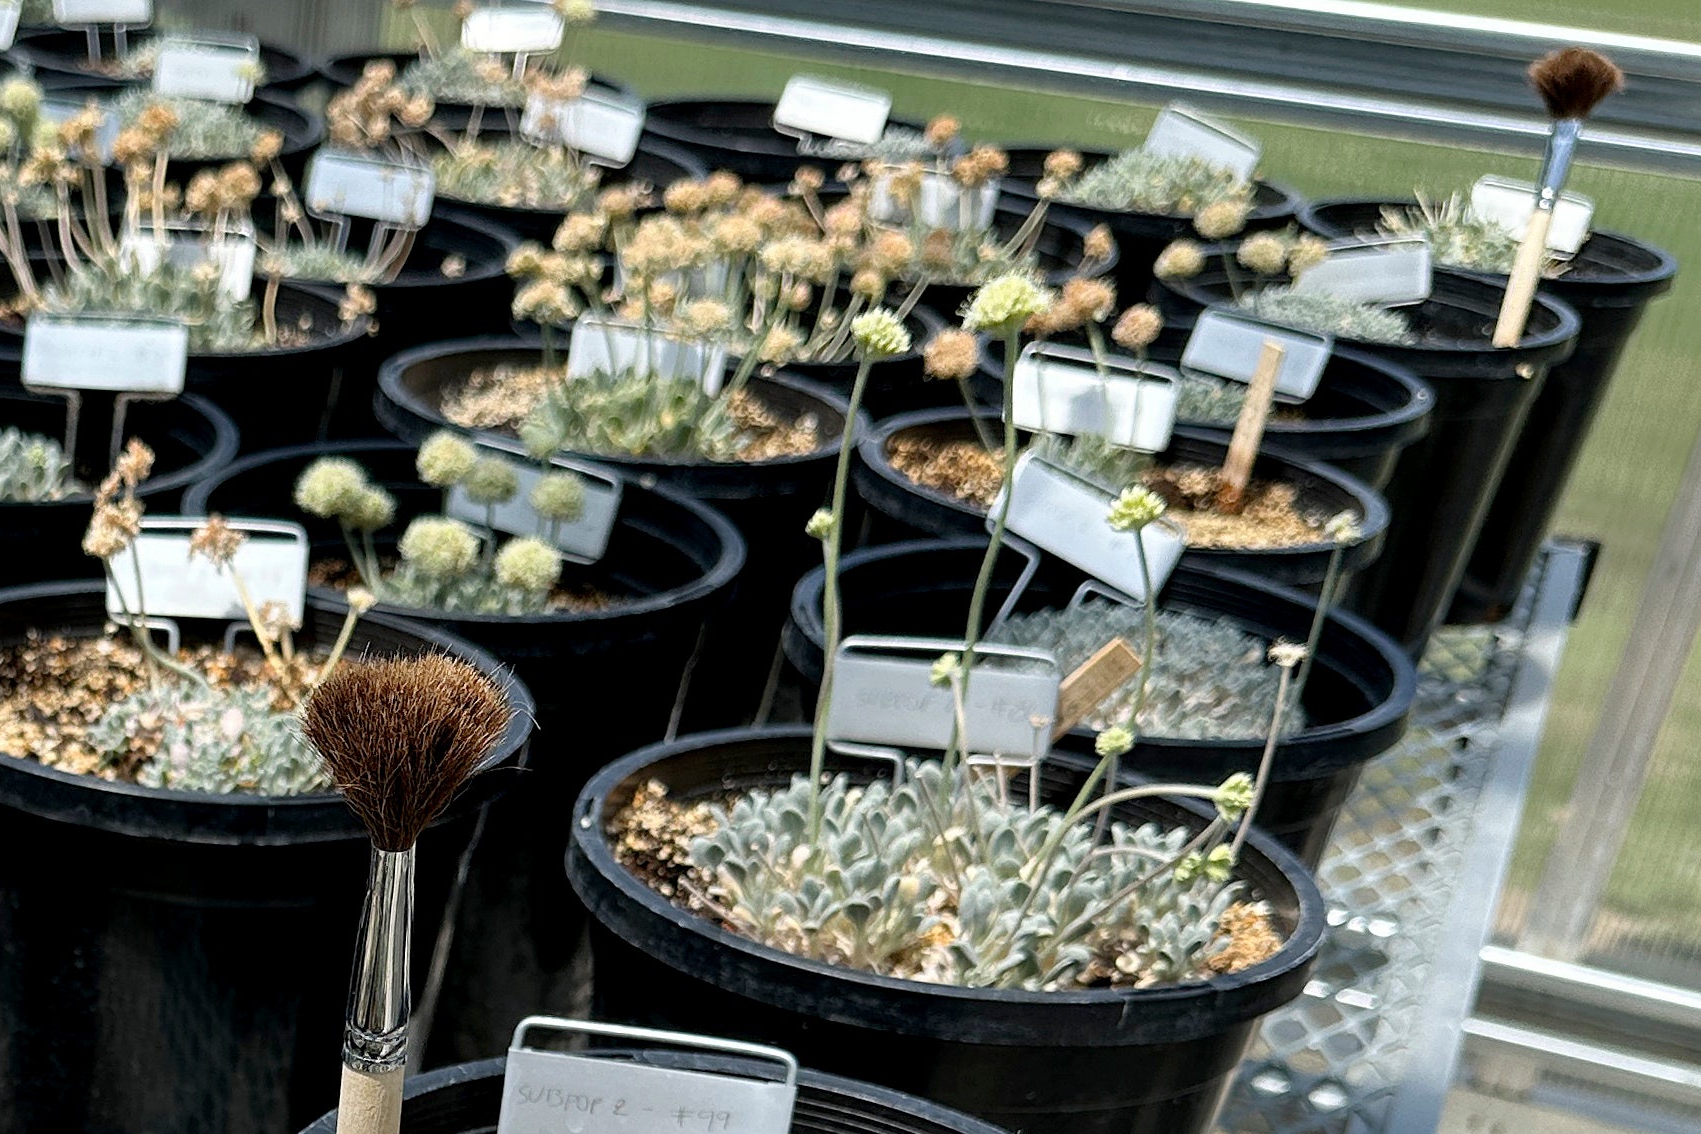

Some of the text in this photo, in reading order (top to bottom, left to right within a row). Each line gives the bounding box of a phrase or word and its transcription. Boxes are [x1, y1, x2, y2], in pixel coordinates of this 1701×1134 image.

[517, 1084, 604, 1115] SUBPOP
[612, 1098, 629, 1118] 2
[670, 1105, 732, 1132] #99
